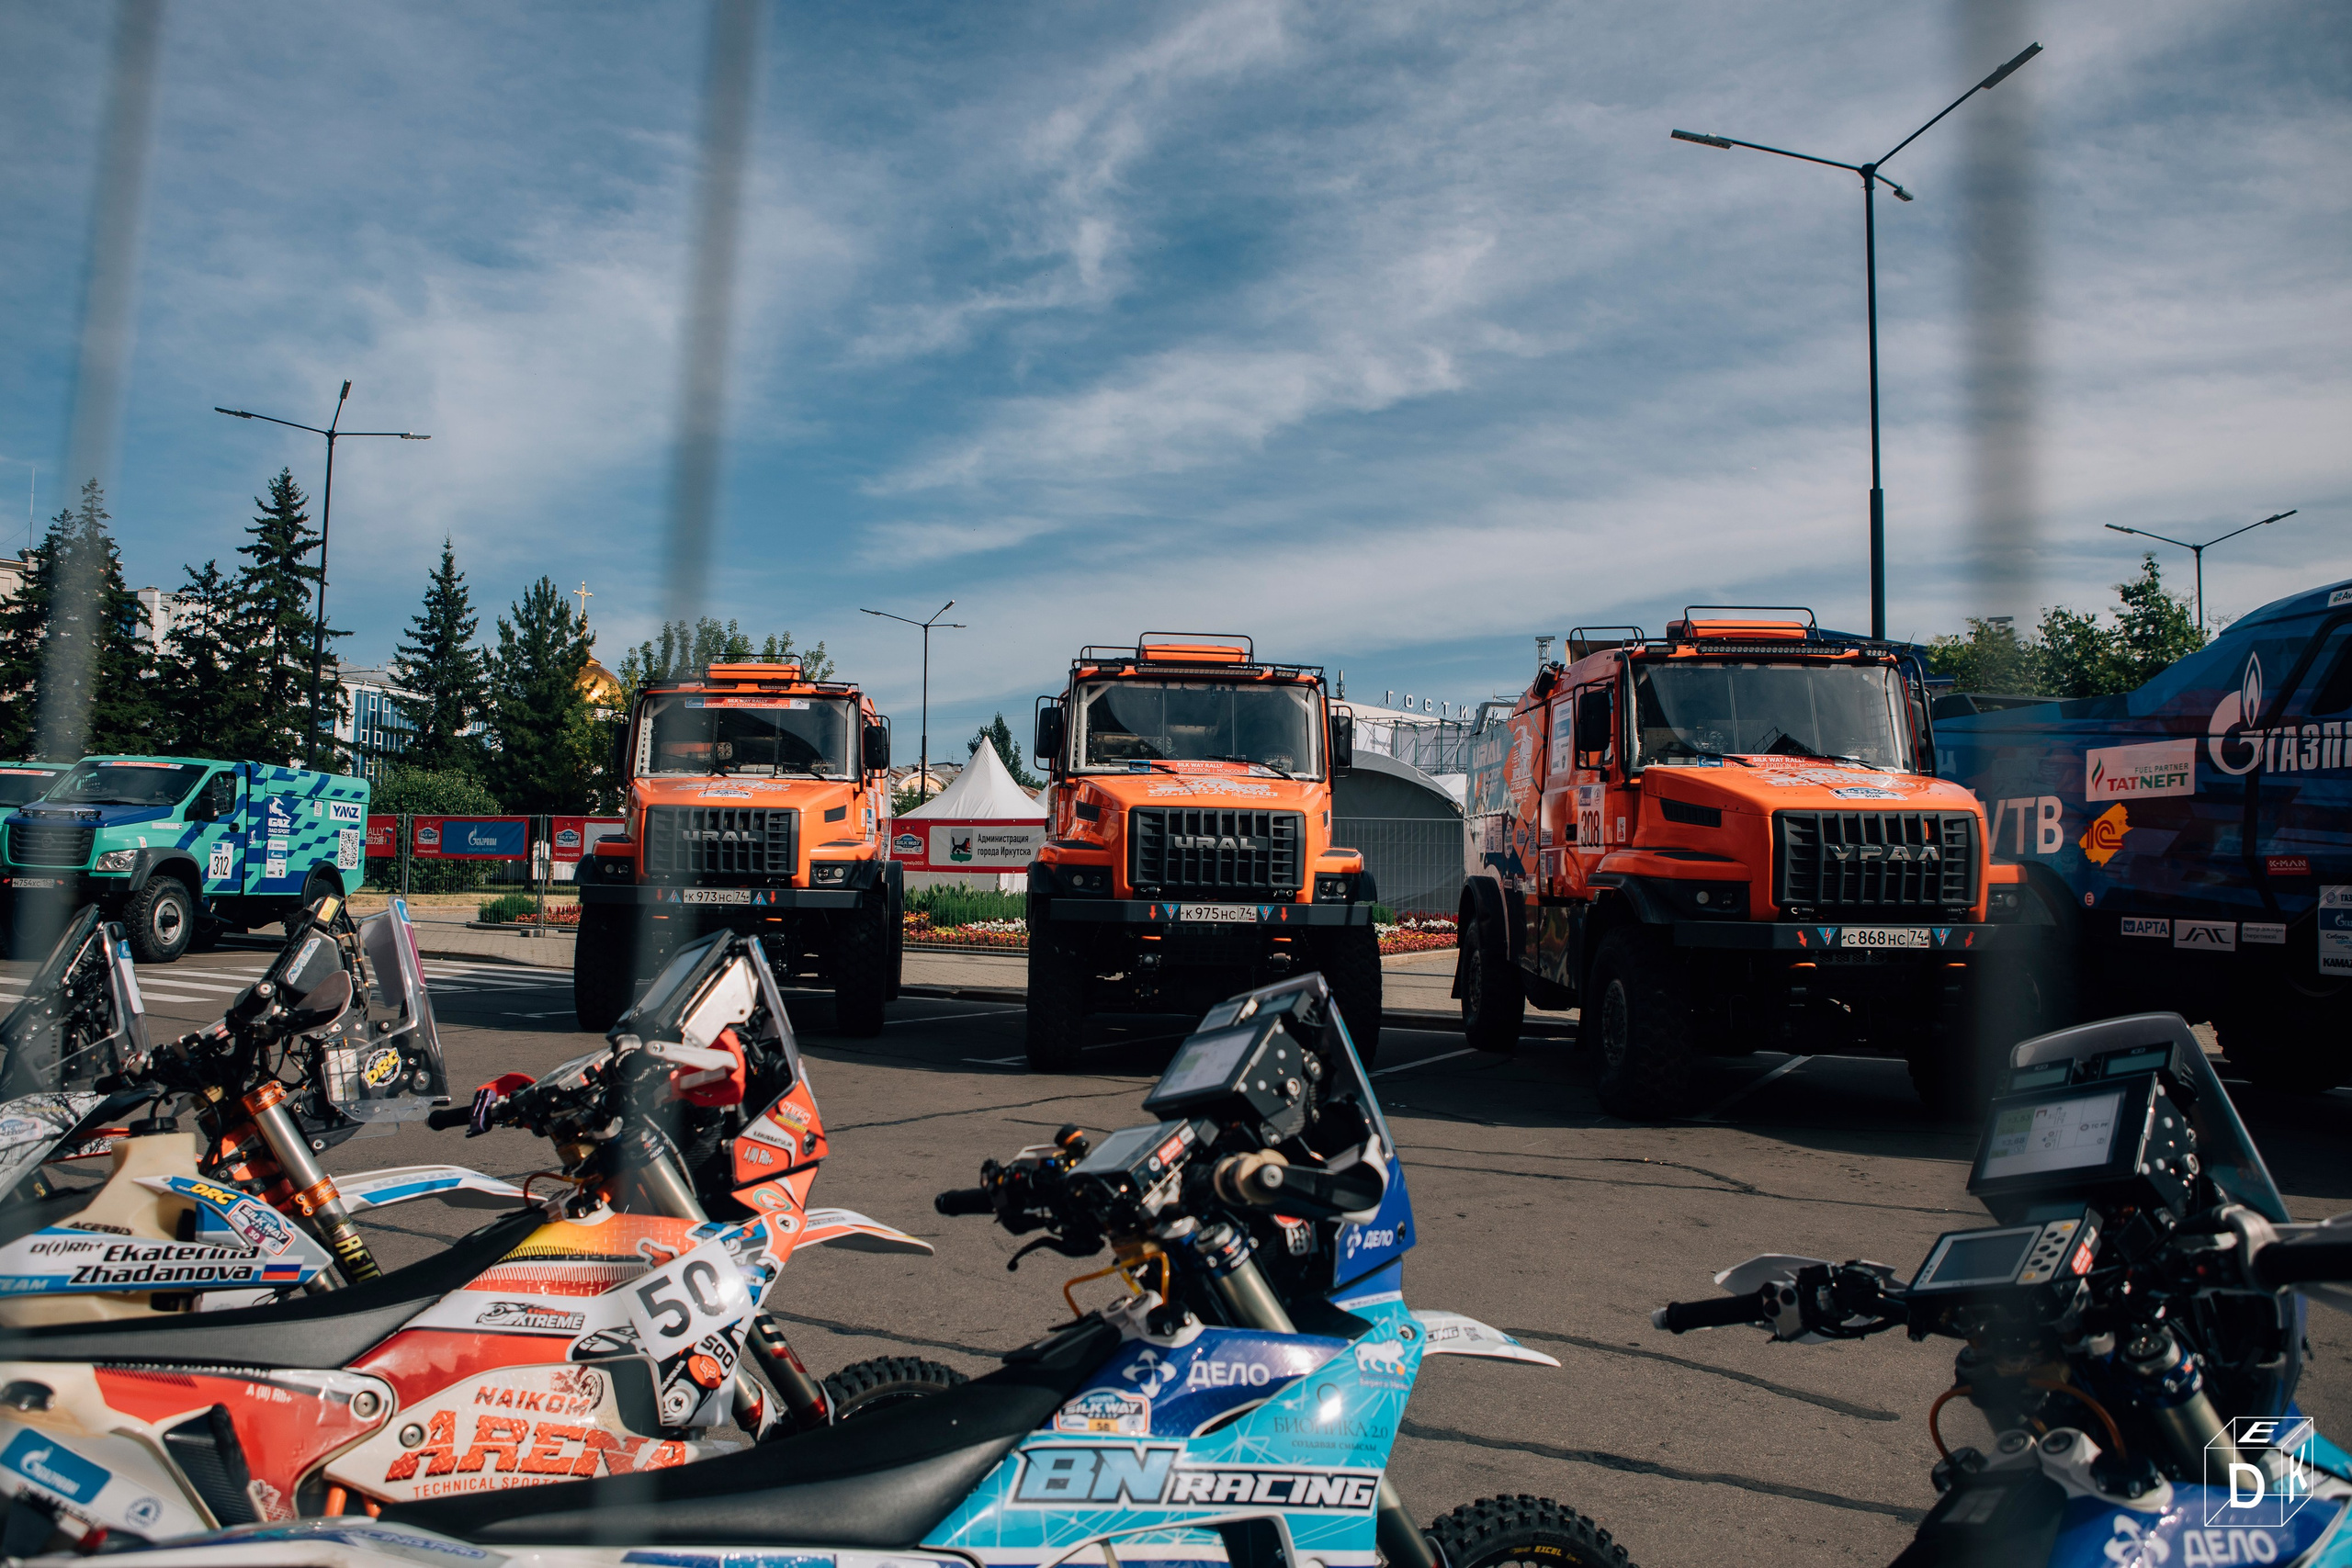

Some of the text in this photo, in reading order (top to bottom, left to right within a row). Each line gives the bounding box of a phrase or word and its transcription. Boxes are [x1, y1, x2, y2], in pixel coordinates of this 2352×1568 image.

[1473, 738, 1503, 770] URAL
[2154, 762, 2189, 773] PARTNER
[2107, 772, 2188, 792] TATNEFT
[367, 827, 386, 836] ALLY
[1581, 810, 1600, 848] 308
[1979, 795, 2064, 855] VTB
[683, 830, 757, 841] URAL
[978, 833, 1029, 844] Администрация
[1174, 837, 1257, 850] URAL
[977, 847, 1032, 858] города Иркутска
[213, 855, 230, 875] 312
[735, 891, 746, 900] 74
[1239, 908, 1252, 917] 74
[1909, 931, 1924, 942] 74
[366, 1049, 400, 1086] DRC
[190, 1183, 239, 1205] DRC
[67, 1221, 134, 1236] ACERBIS
[240, 1206, 289, 1241] SILK WAY
[248, 1229, 261, 1241] 30
[1363, 1229, 1395, 1250] ДЕЛО
[103, 1243, 260, 1263] Ekaterina
[68, 1264, 254, 1285] Zhadanova
[638, 1259, 729, 1337] 50
[1426, 1325, 1459, 1343] CING
[700, 1334, 734, 1369] 500
[1187, 1360, 1271, 1388] ДЕЛО
[245, 1382, 254, 1396] A
[474, 1385, 593, 1416] NAIKOM
[1064, 1402, 1139, 1415] SILK WAY
[1370, 1425, 1389, 1439] 2.0
[385, 1409, 686, 1483] ARENA
[1291, 1438, 1337, 1450] создавая
[413, 1478, 496, 1499] TECHNICAL
[1014, 1448, 1377, 1509] BN RACING
[1533, 1545, 1562, 1557] EXCEL
[2183, 1529, 2278, 1567] ДЕЛО
